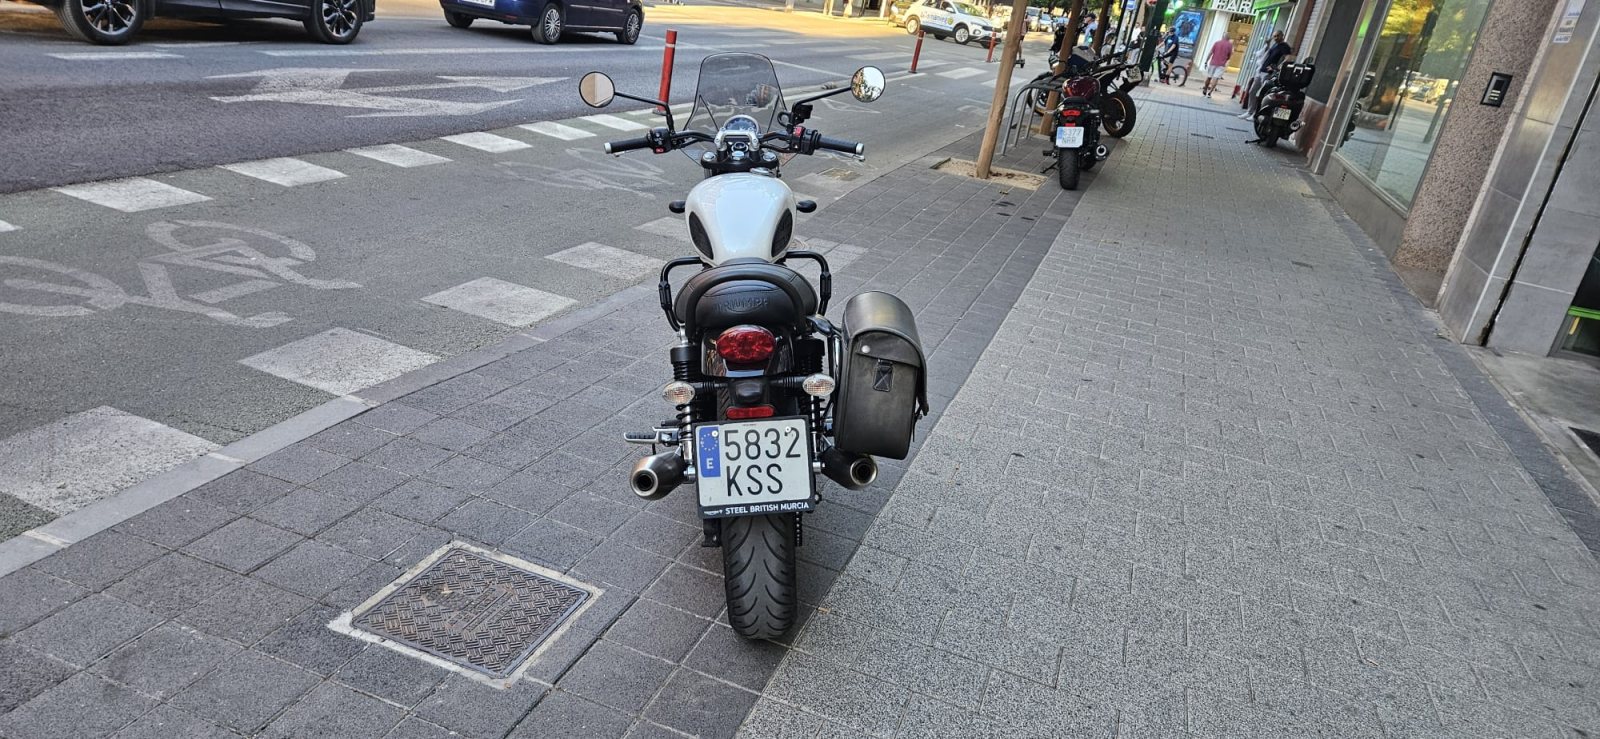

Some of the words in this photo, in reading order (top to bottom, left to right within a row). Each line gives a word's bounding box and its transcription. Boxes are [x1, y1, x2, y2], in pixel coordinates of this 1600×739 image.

[724, 427, 801, 461] 5832
[706, 458, 714, 470] E
[726, 463, 783, 497] KSS
[725, 506, 748, 515] STEEL
[750, 504, 779, 513] BRITISH
[780, 502, 810, 511] MURCIA
